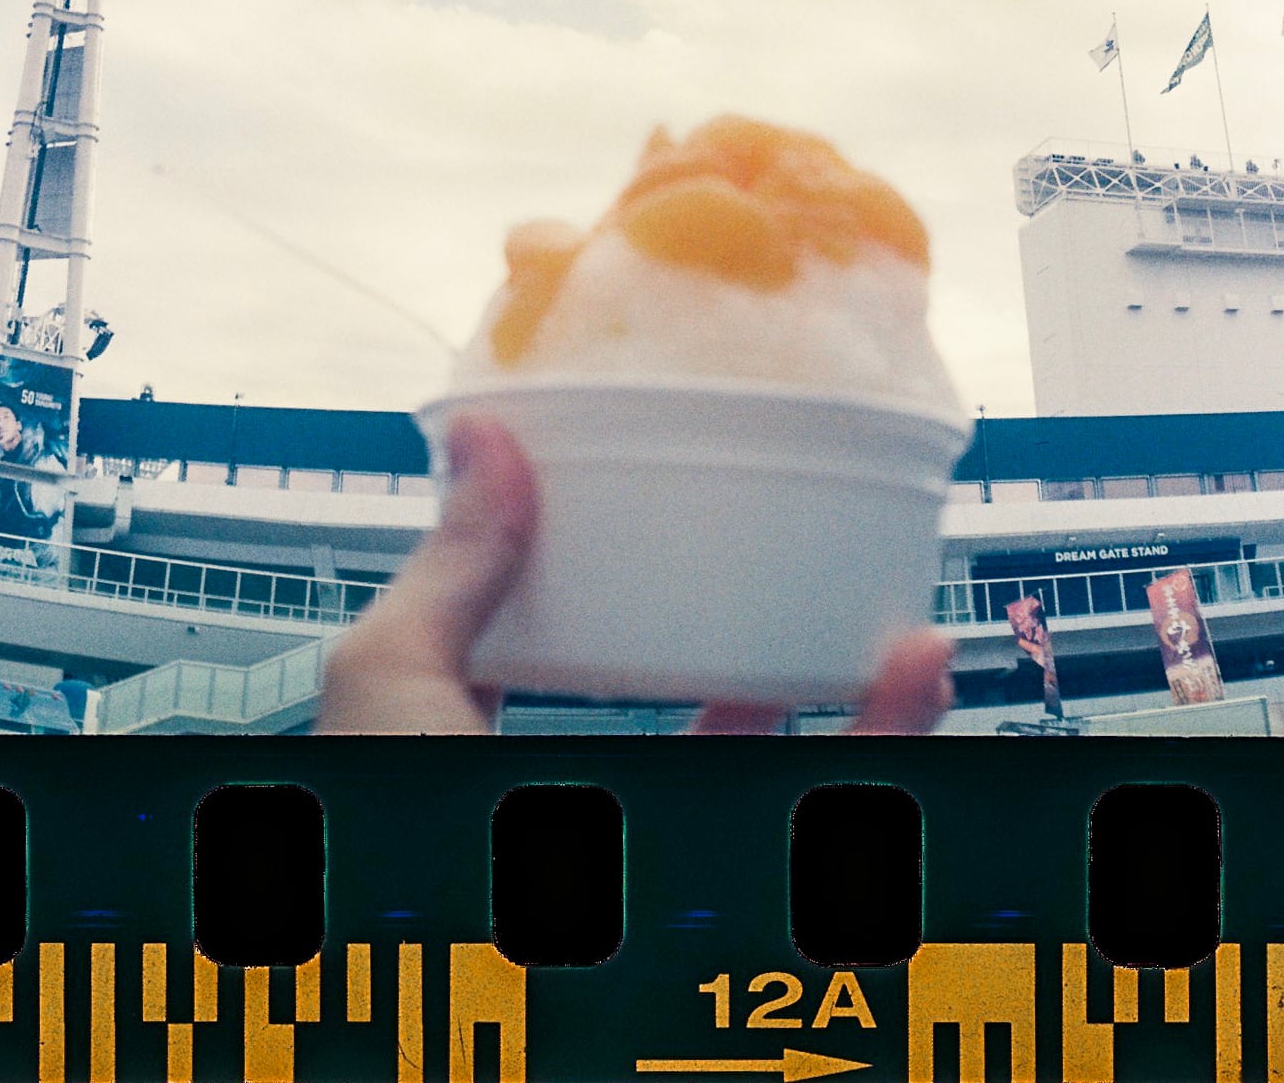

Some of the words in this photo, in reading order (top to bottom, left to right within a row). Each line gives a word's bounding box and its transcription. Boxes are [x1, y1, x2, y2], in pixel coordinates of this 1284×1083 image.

[21, 389, 35, 405] 50
[1055, 550, 1097, 562] DREAM
[1099, 548, 1129, 559] GATE
[1131, 545, 1168, 557] STAND
[698, 972, 877, 1029] 12A
